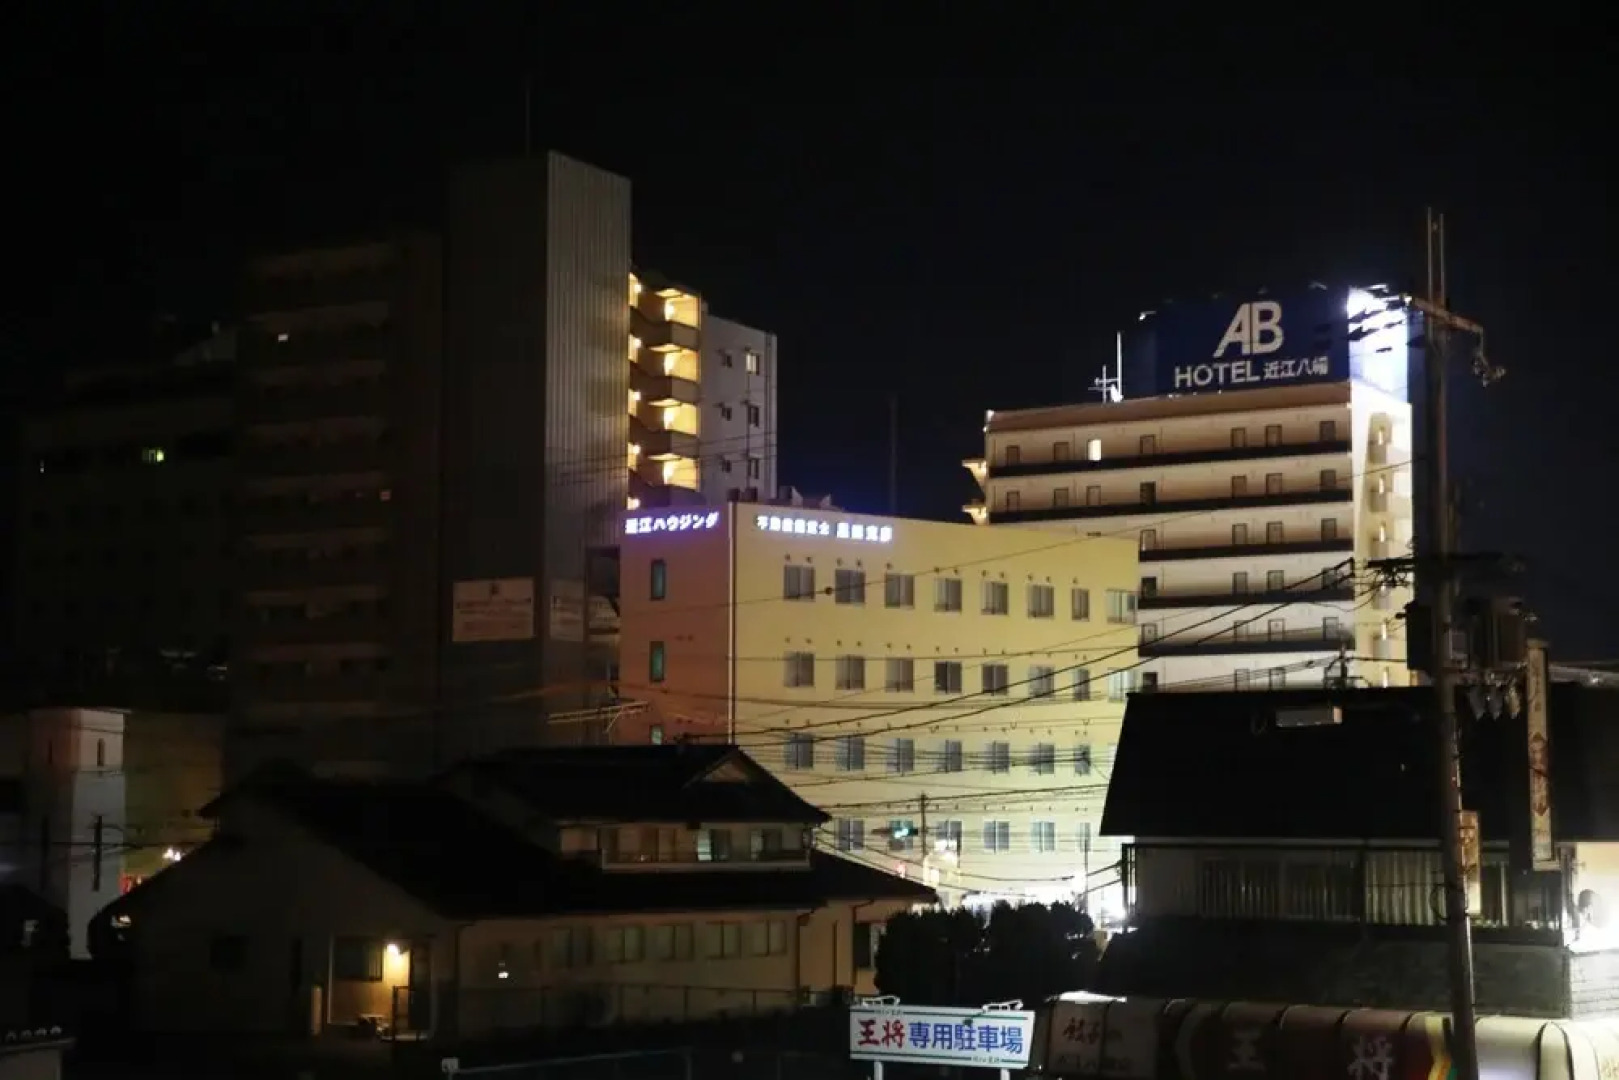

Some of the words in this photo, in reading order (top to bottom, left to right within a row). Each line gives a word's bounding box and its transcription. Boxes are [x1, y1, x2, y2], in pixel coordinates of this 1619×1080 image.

[1213, 301, 1284, 358] AB
[1174, 360, 1261, 388] HOTEL
[858, 1018, 1024, 1054] 王将専用駐車場
